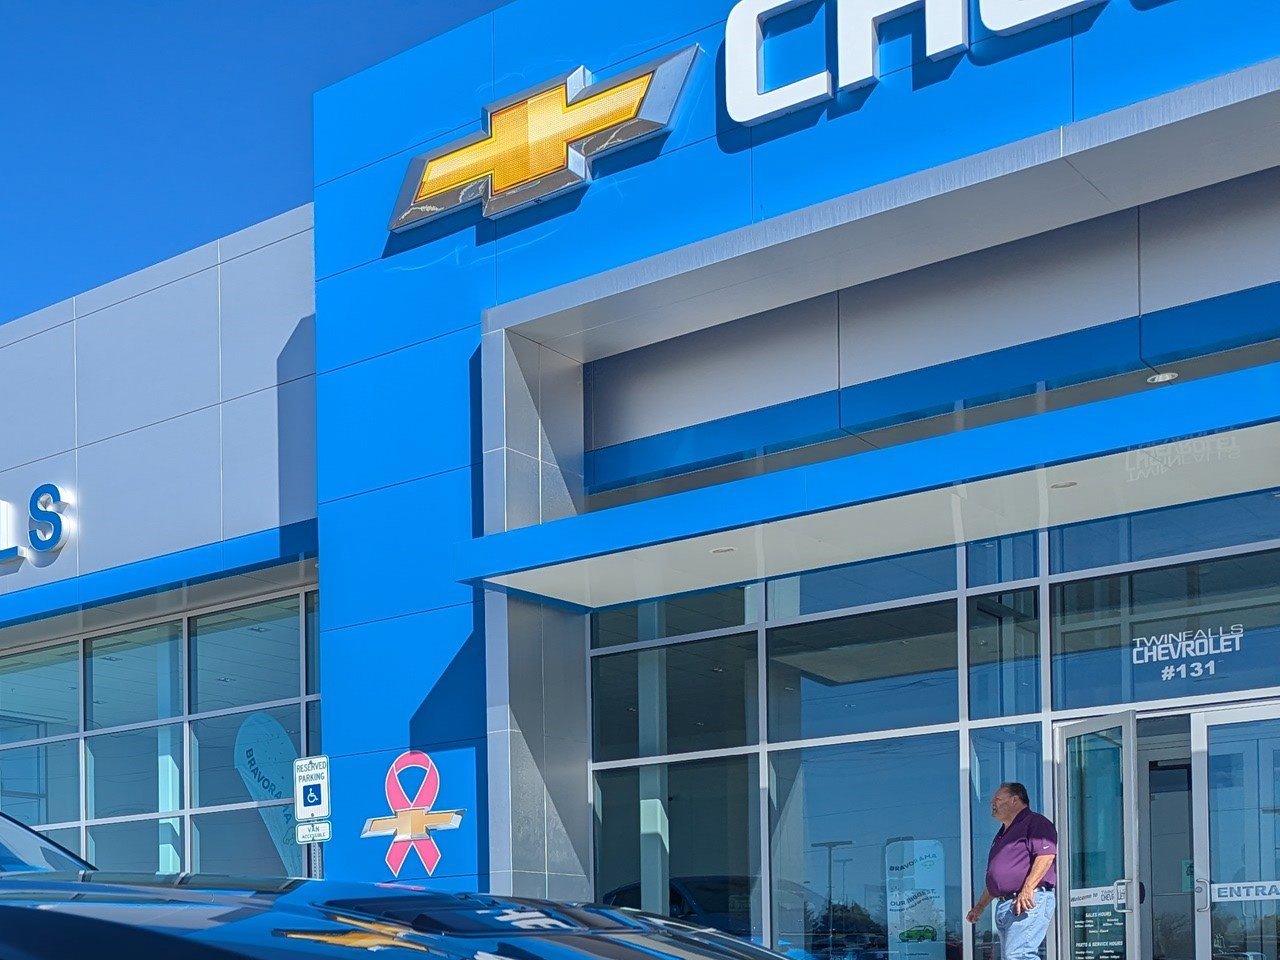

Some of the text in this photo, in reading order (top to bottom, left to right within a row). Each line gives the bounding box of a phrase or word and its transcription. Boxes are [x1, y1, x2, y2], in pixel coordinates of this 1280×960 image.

[725, 0, 1108, 127] CH
[1133, 624, 1243, 647] TWINFALLS
[1133, 634, 1244, 664] CHEVROLET
[1161, 660, 1215, 681] #131
[297, 761, 327, 773] RESERVED
[299, 772, 324, 783] PARKING
[1217, 884, 1280, 898] ENTRA
